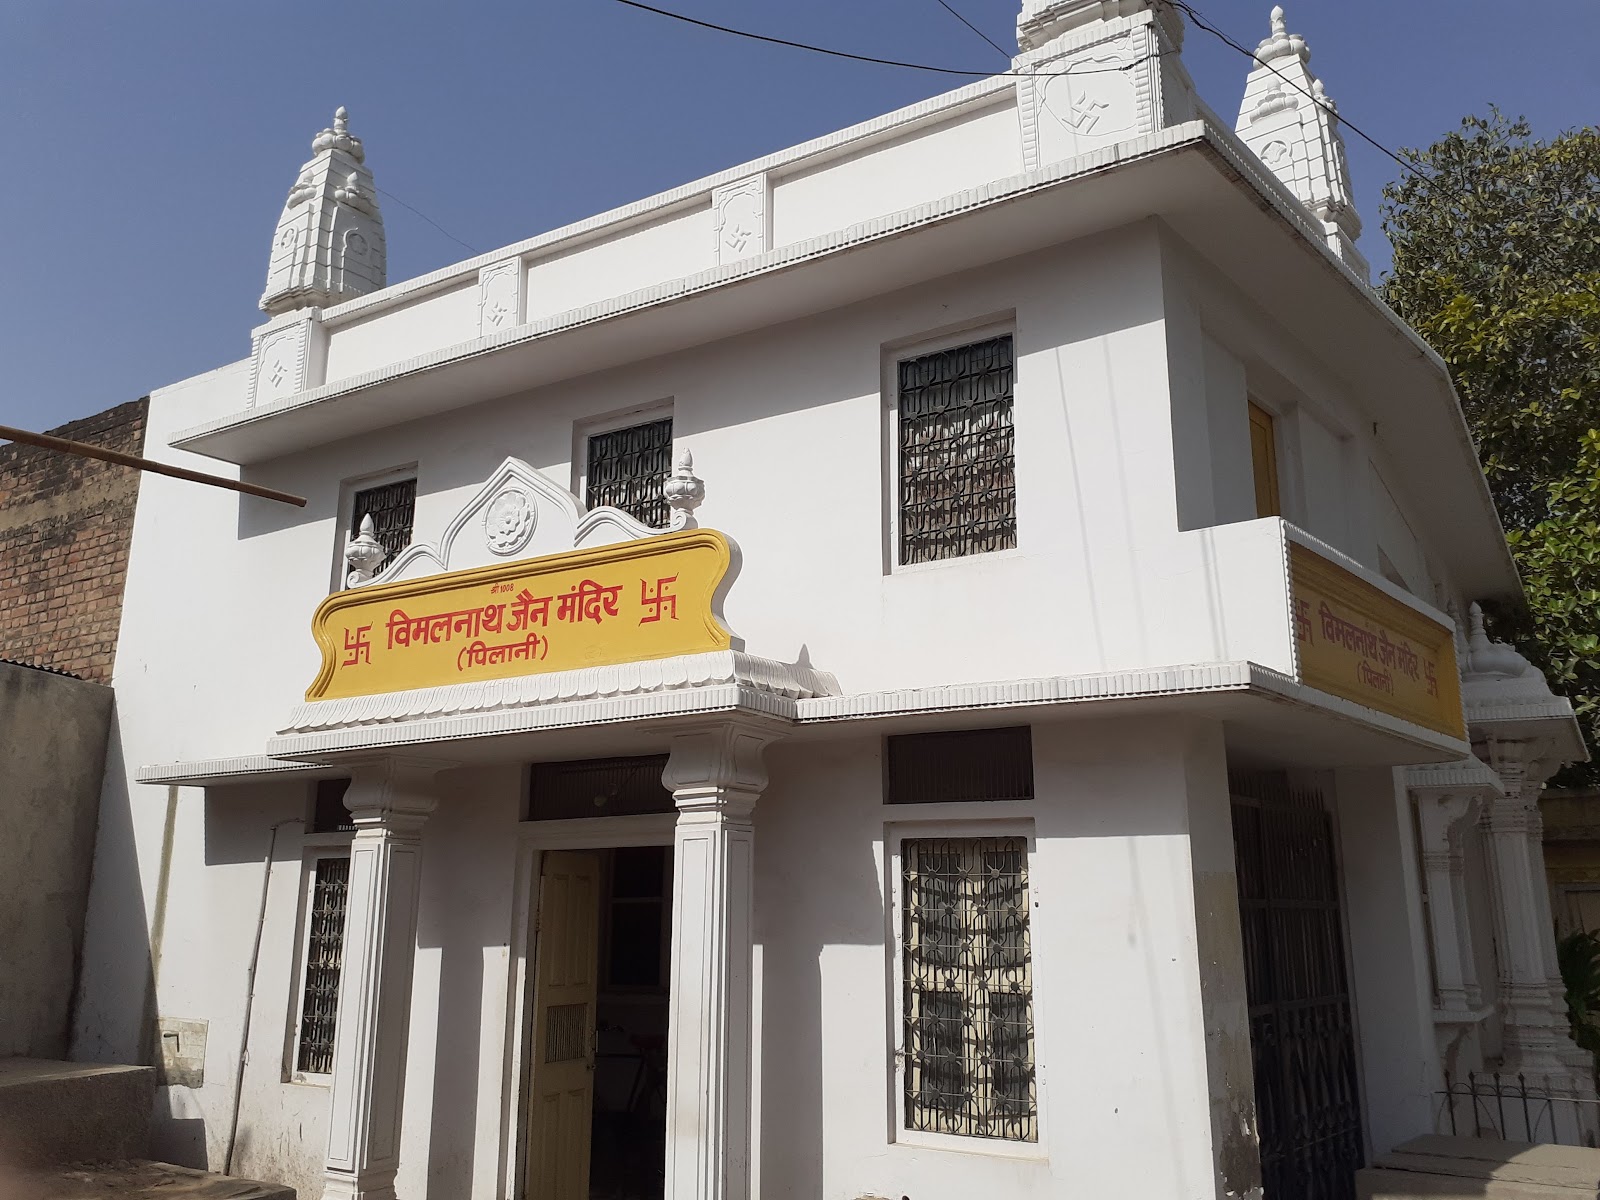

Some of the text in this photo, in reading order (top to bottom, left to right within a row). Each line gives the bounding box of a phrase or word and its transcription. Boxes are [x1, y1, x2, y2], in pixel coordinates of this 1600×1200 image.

[490, 582, 514, 594] श्री 1008
[386, 579, 623, 650] विमलनाथ जैन मंदिर
[1318, 601, 1378, 662] विमलनाथ
[457, 633, 548, 672] (पिलानी)
